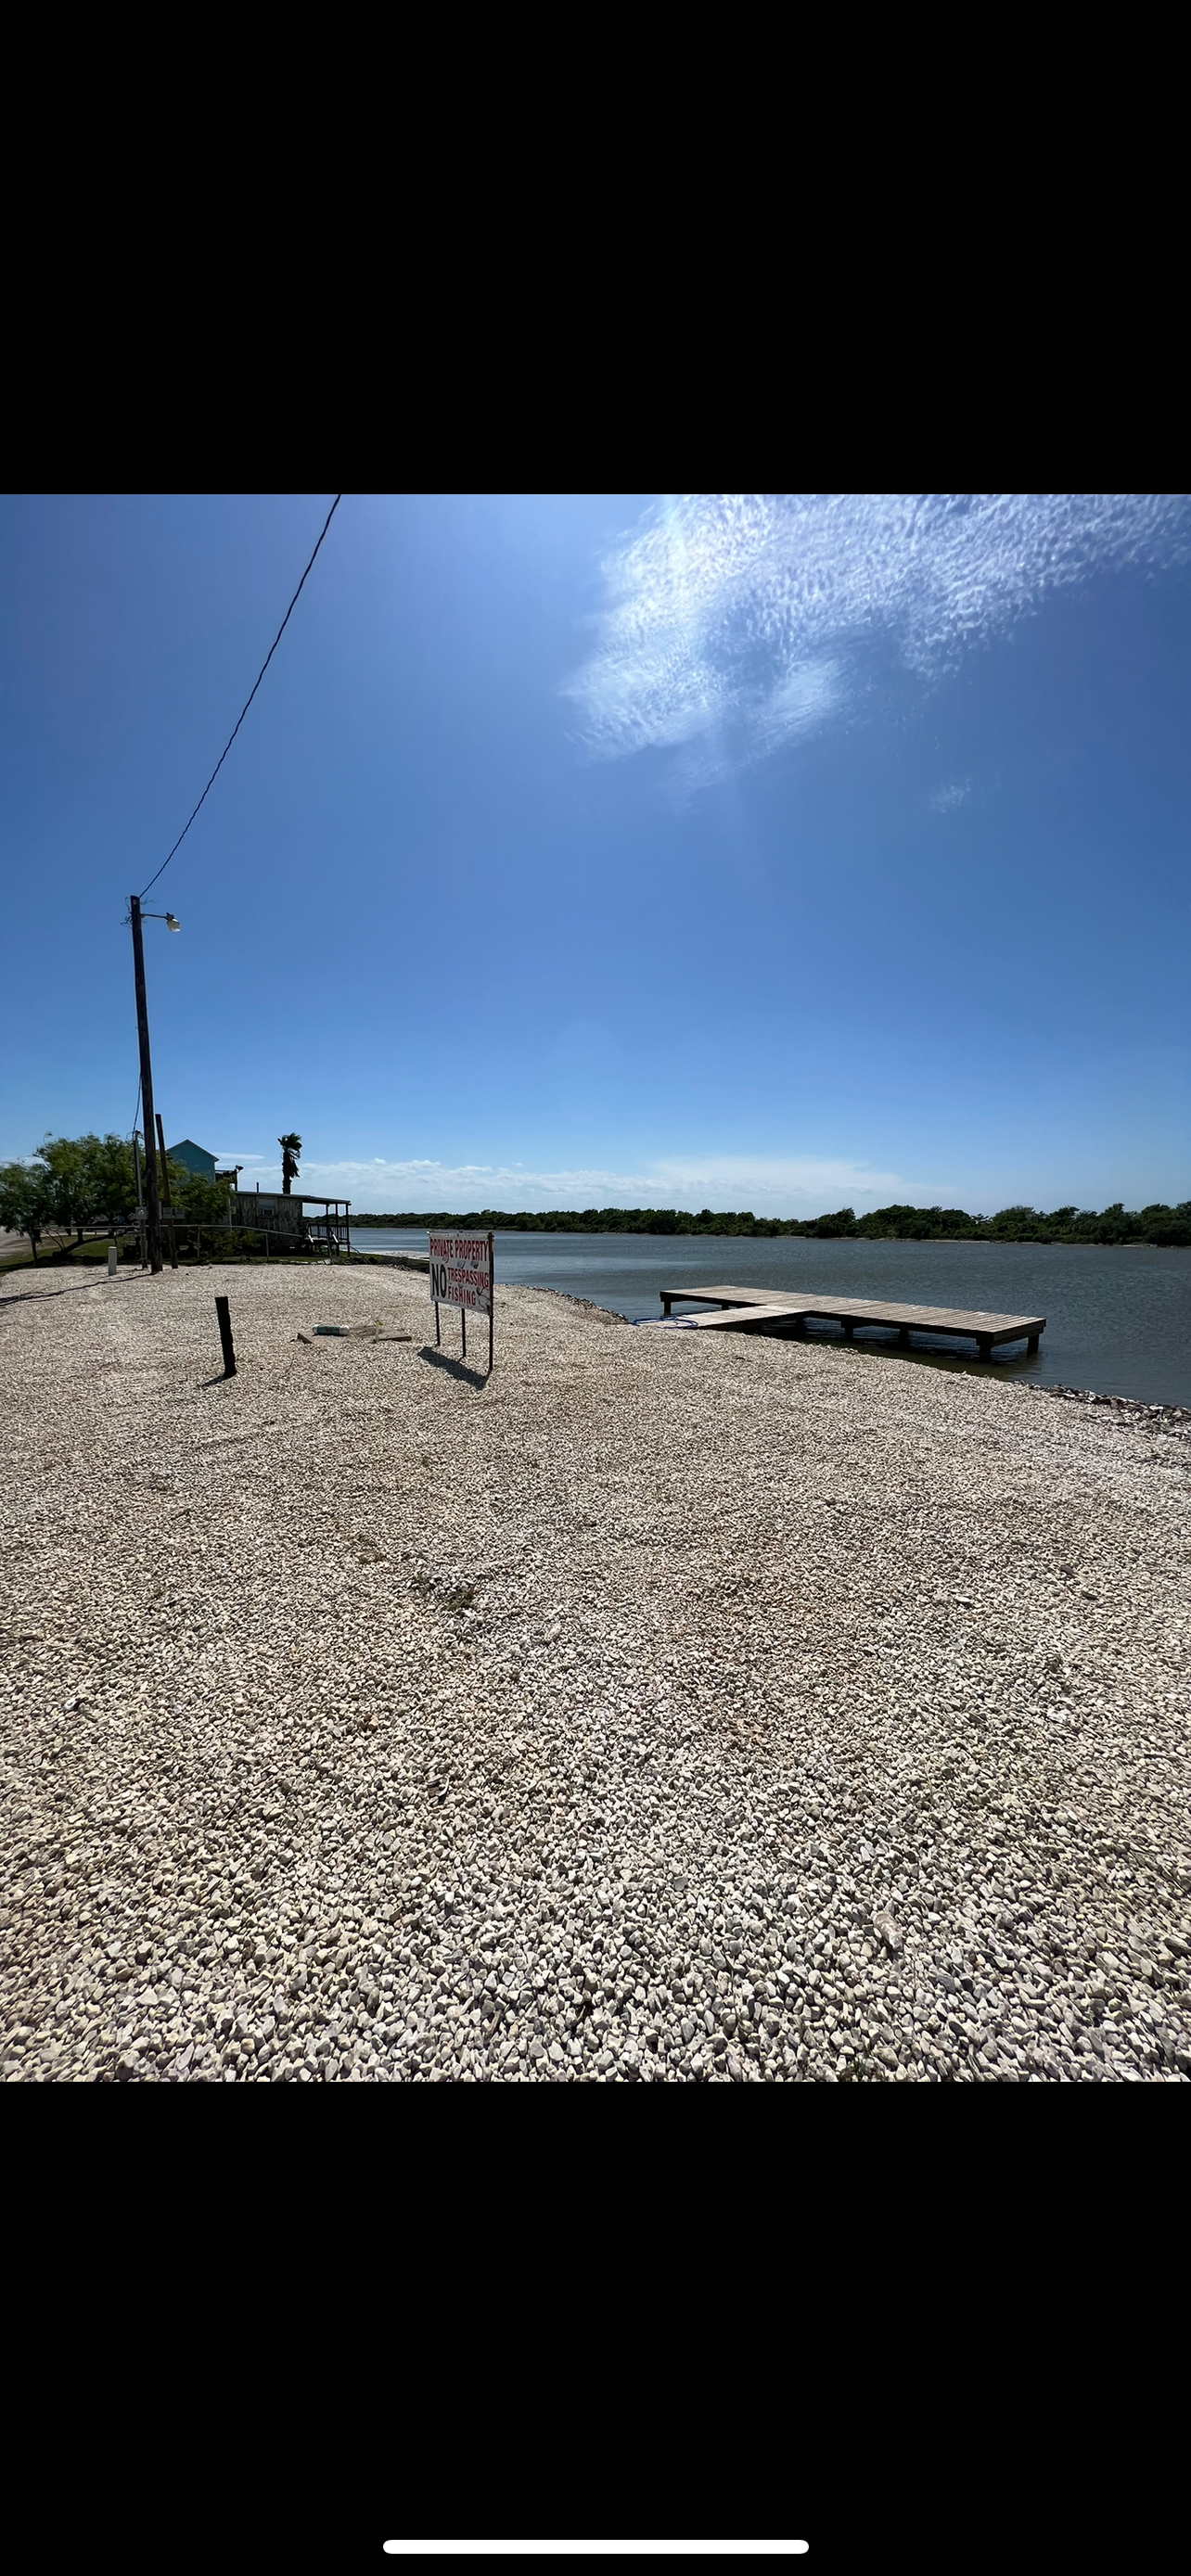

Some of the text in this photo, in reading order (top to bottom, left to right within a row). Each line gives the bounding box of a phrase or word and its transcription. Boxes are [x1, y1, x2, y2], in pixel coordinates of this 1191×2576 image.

[429, 1238, 489, 1261] PRIVATE PROPERTY
[431, 1263, 447, 1298] NO
[447, 1267, 489, 1287] TRESPASSING
[448, 1285, 476, 1306] FISHING
